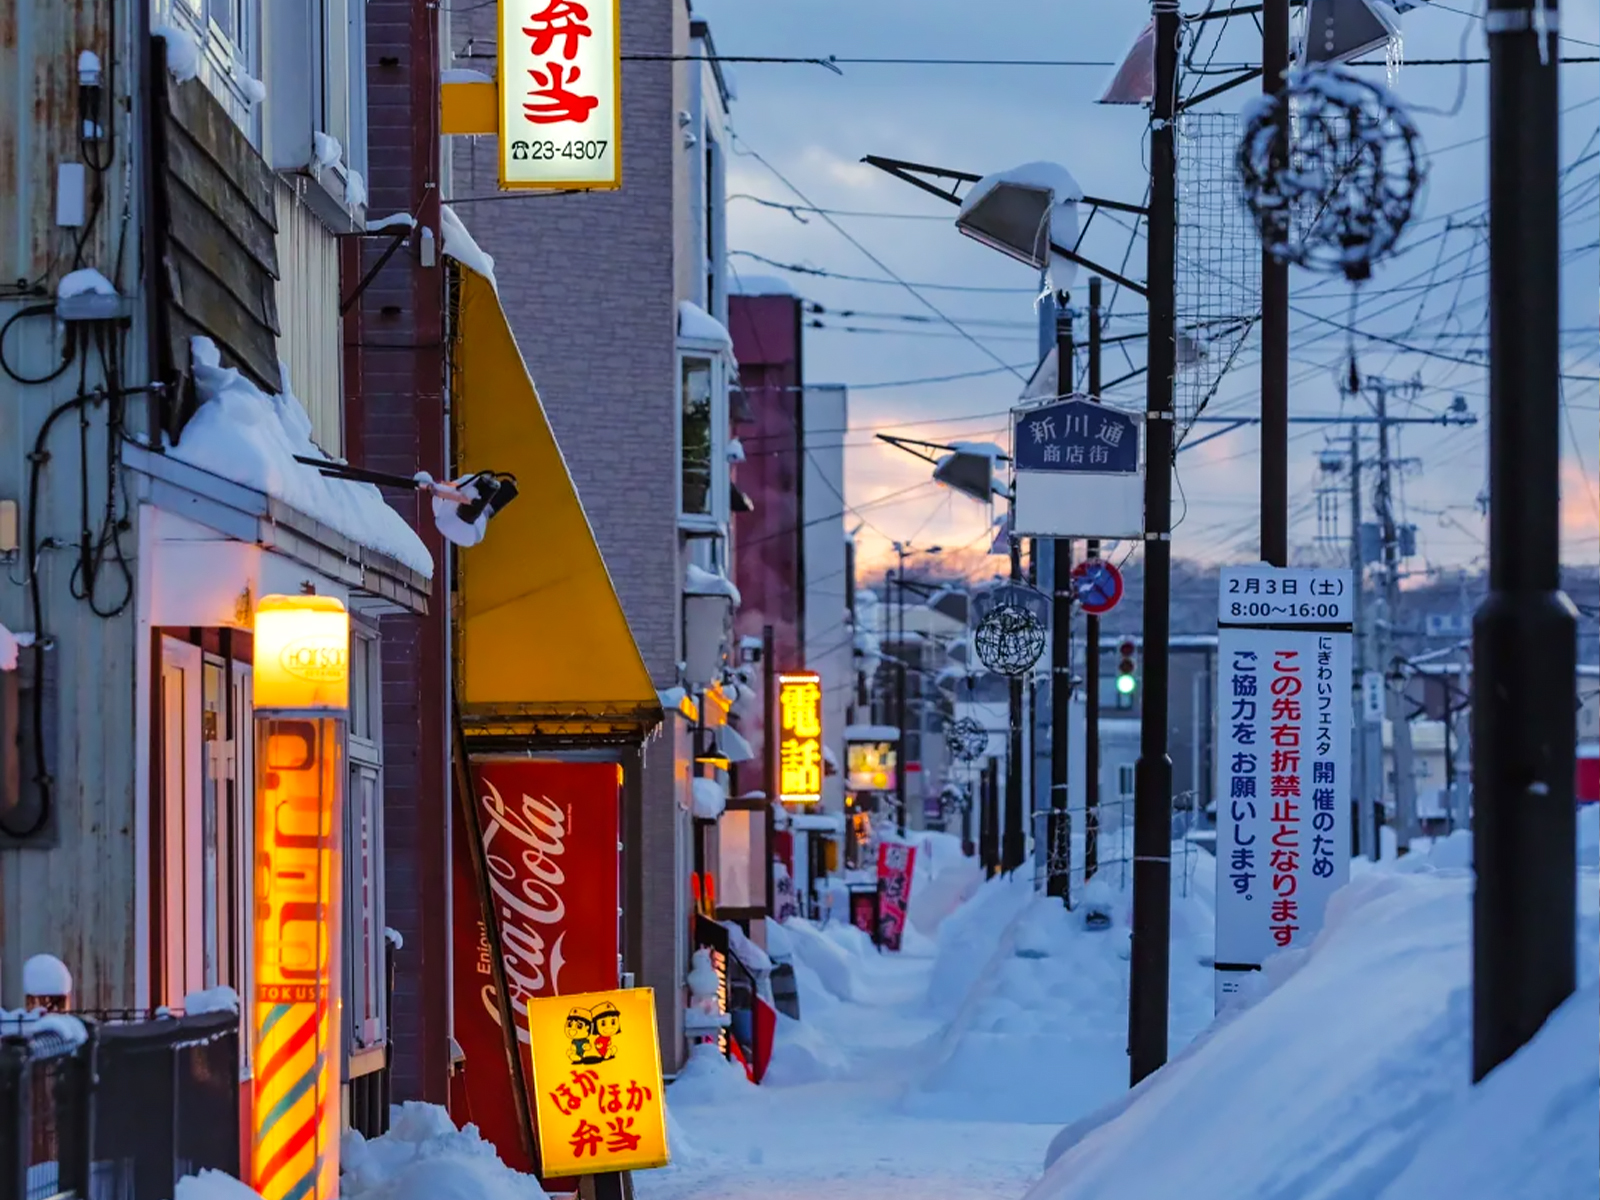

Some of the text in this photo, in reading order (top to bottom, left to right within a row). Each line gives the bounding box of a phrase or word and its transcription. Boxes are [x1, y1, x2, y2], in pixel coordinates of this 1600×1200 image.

[522, 0, 599, 124] 弁当
[532, 140, 608, 160] 23-4307
[1029, 414, 1126, 447] 新川通
[1043, 444, 1109, 464] 商店街
[1269, 651, 1302, 947] この先右折禁止となります
[549, 1069, 652, 1115] ほかほか
[568, 1116, 641, 1158] 弁当
